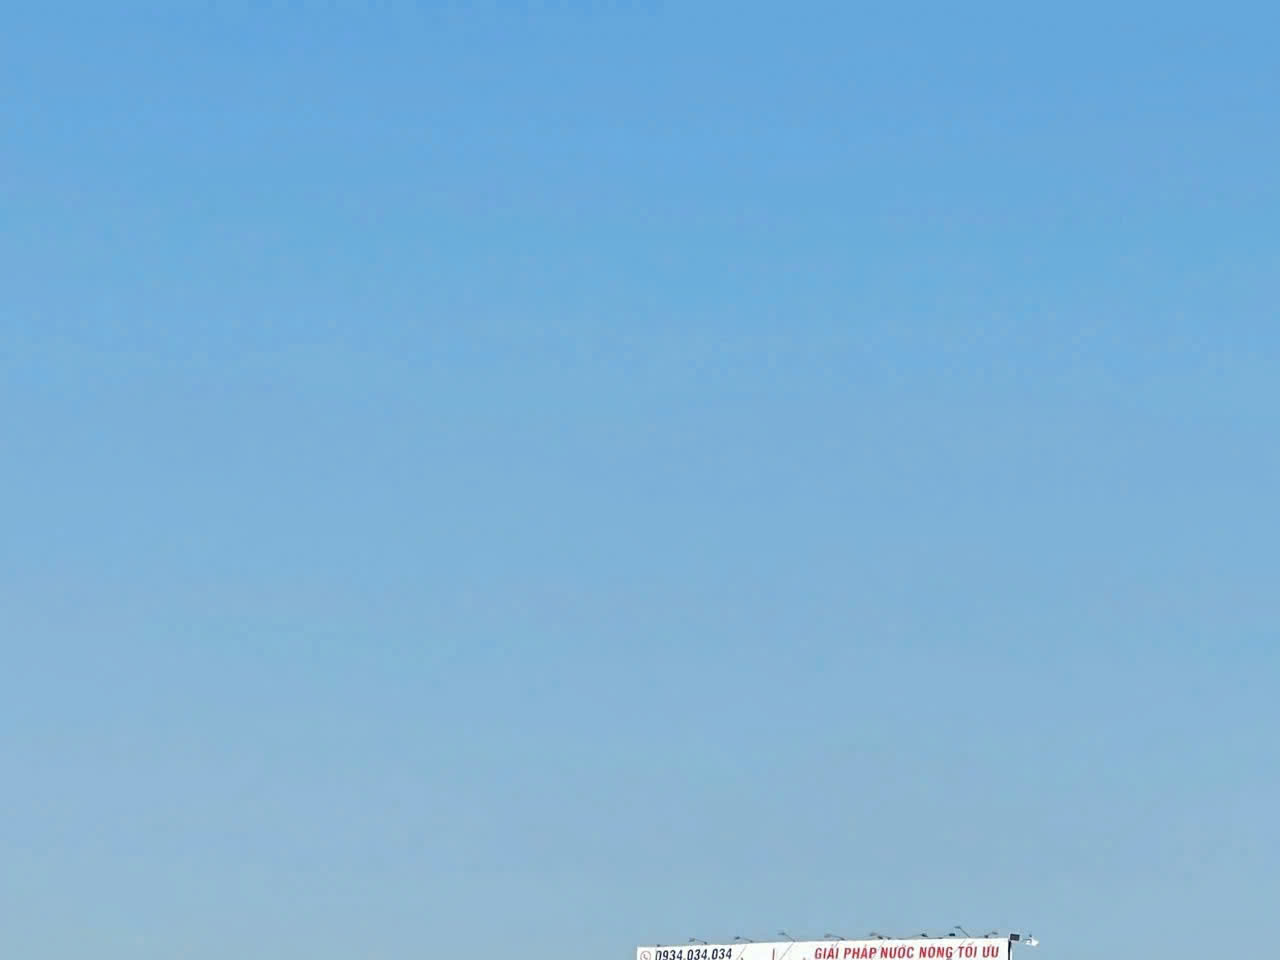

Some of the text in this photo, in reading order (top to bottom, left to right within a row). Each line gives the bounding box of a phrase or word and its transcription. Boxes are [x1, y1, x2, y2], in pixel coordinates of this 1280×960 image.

[843, 945, 877, 960] PHÁP
[880, 944, 915, 959] NƯỚC
[919, 944, 953, 959] NÓNG
[982, 945, 1000, 958] ƯU
